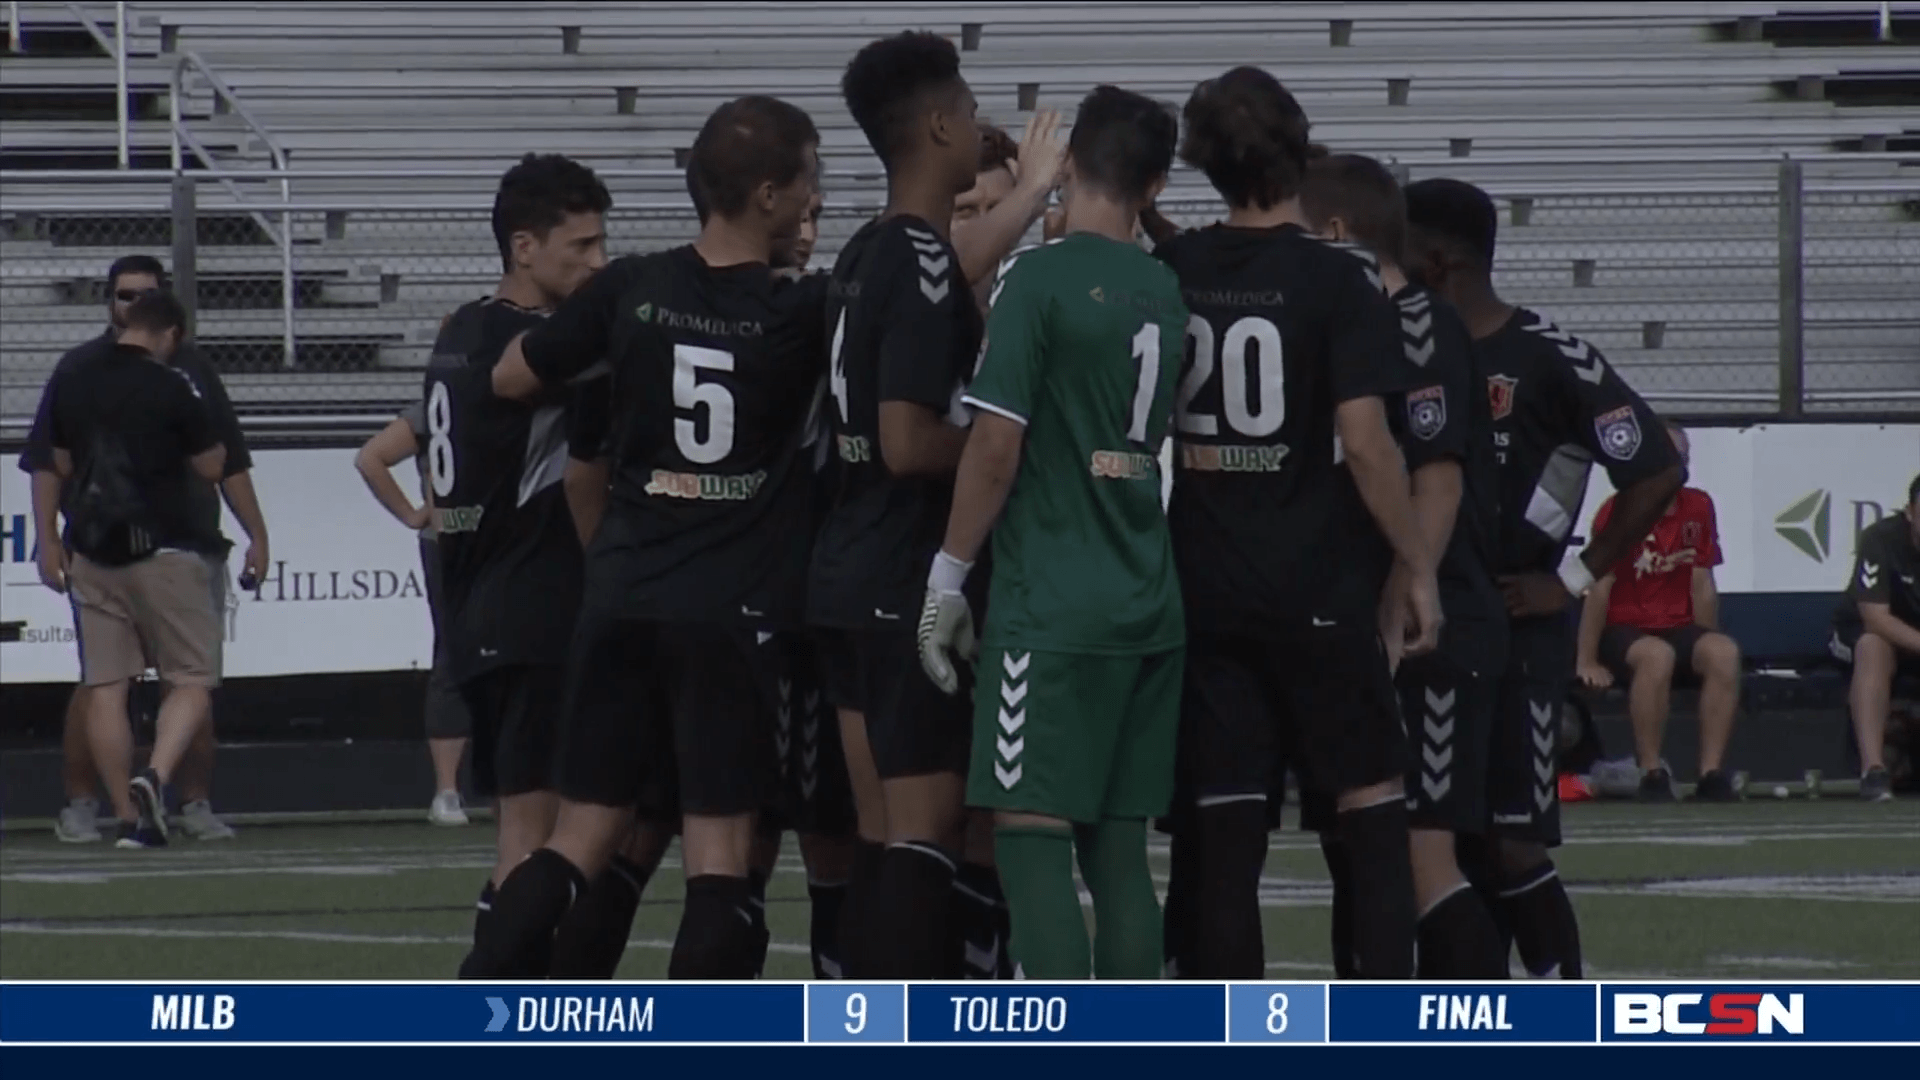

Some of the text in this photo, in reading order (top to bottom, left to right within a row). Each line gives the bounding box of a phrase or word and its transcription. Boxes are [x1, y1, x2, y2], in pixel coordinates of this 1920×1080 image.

[672, 342, 736, 464] 5
[1126, 322, 1161, 442] 1
[1176, 314, 1286, 437] 20
[427, 380, 456, 497] 8
[24, 625, 76, 644] sulta
